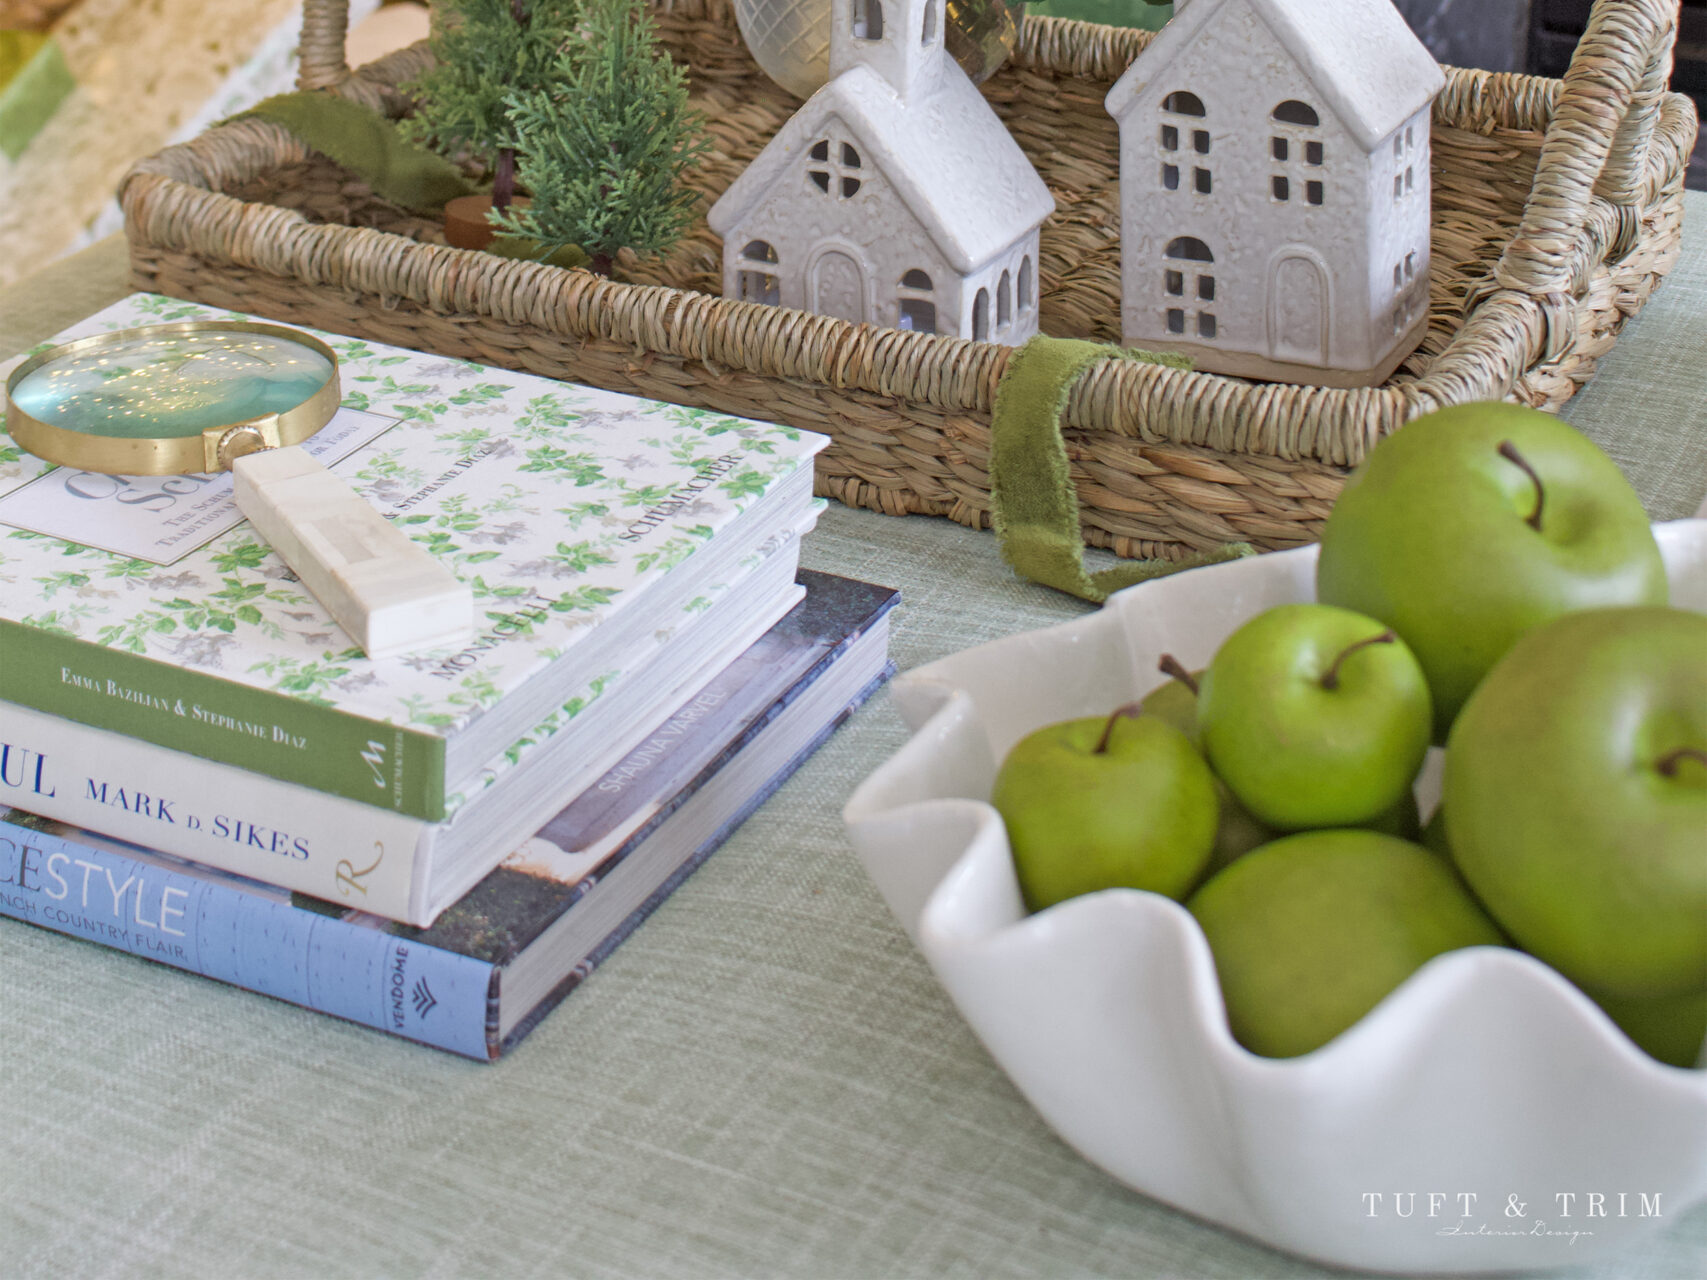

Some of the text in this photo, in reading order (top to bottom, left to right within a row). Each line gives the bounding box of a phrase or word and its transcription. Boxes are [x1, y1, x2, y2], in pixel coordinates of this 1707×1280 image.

[162, 511, 197, 526] THE
[191, 487, 235, 511] SCHUM
[381, 511, 401, 520] &
[617, 454, 745, 543] SCHUMACHER
[428, 595, 559, 681] MONACELLI
[174, 699, 187, 717] &
[598, 691, 727, 793] SHAUNA VARVEL
[0, 742, 56, 798] UL
[84, 777, 176, 824] MARK
[211, 814, 310, 861] SIKES
[336, 840, 384, 896] R
[0, 893, 37, 915] NCH
[43, 906, 129, 941] COUNTRY
[391, 946, 409, 1029] VENDOME
